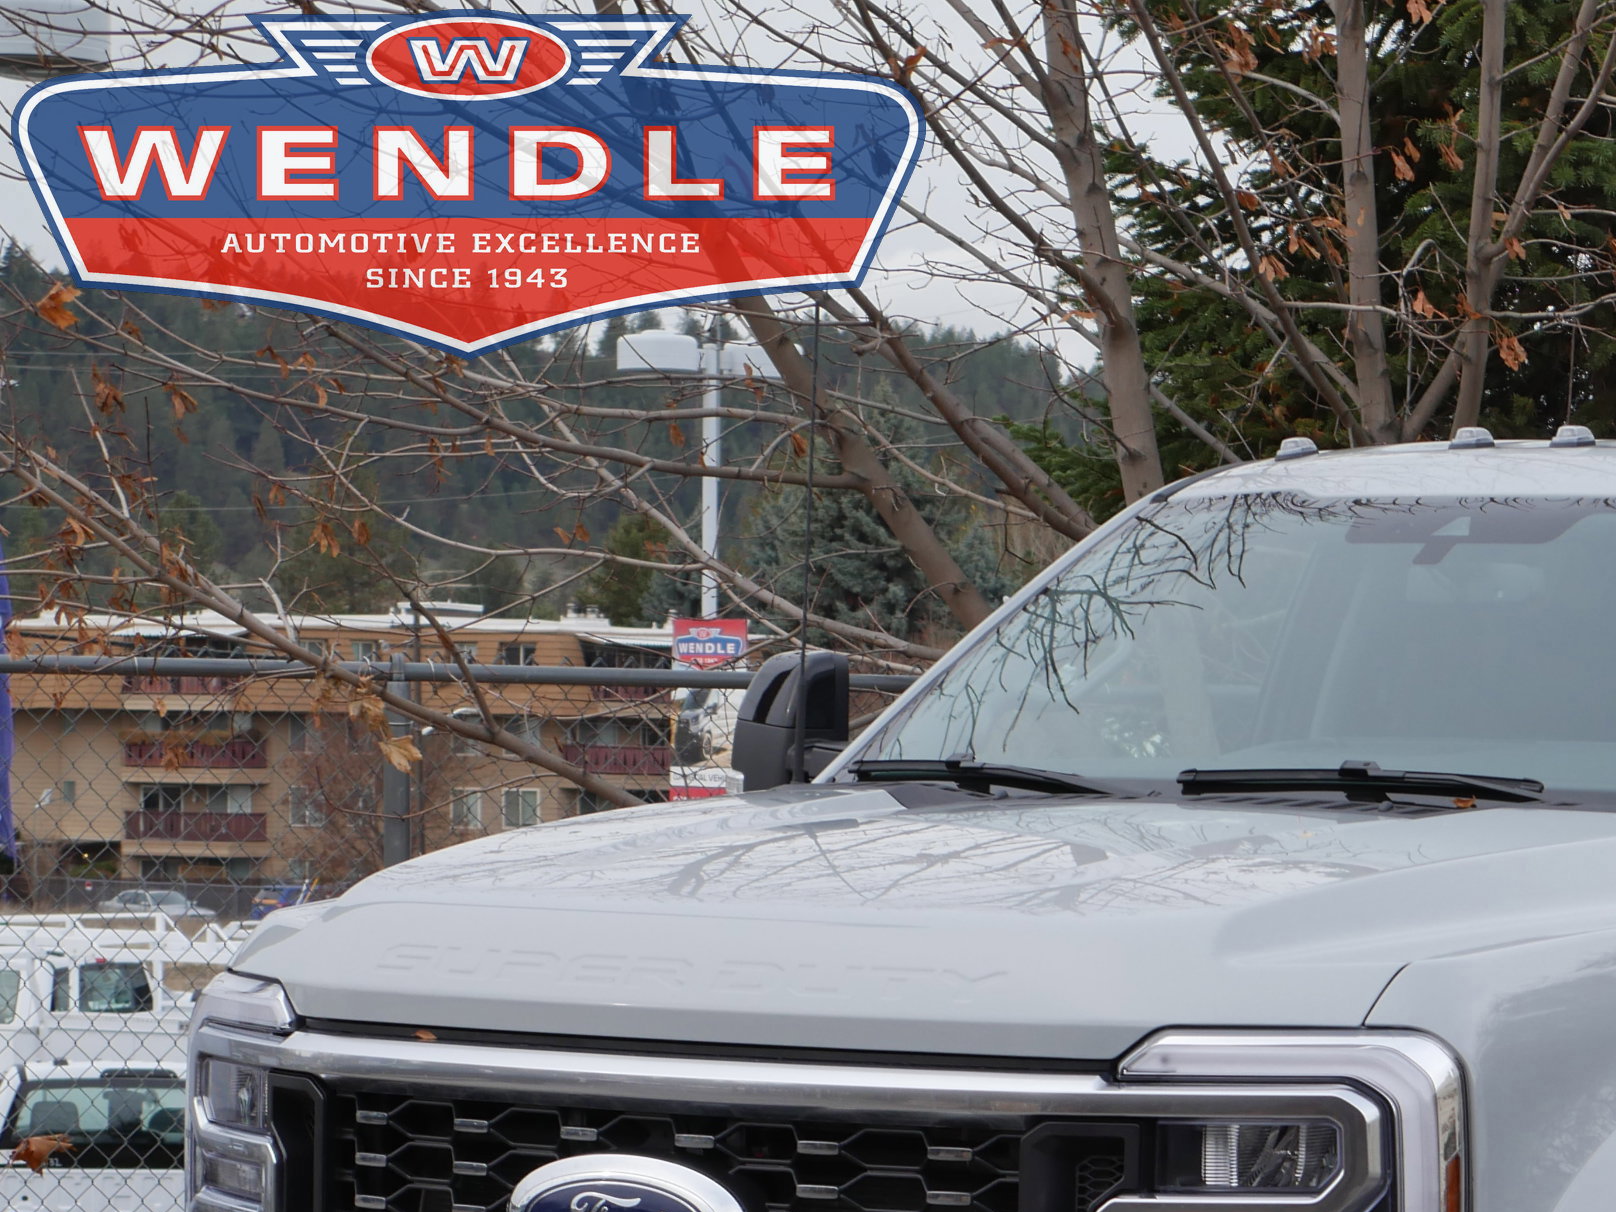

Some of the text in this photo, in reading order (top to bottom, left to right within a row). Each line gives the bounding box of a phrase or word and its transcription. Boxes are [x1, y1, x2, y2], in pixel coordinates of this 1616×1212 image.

[678, 642, 735, 654] WENDLE
[376, 942, 1010, 1004] SUPER DUTY
